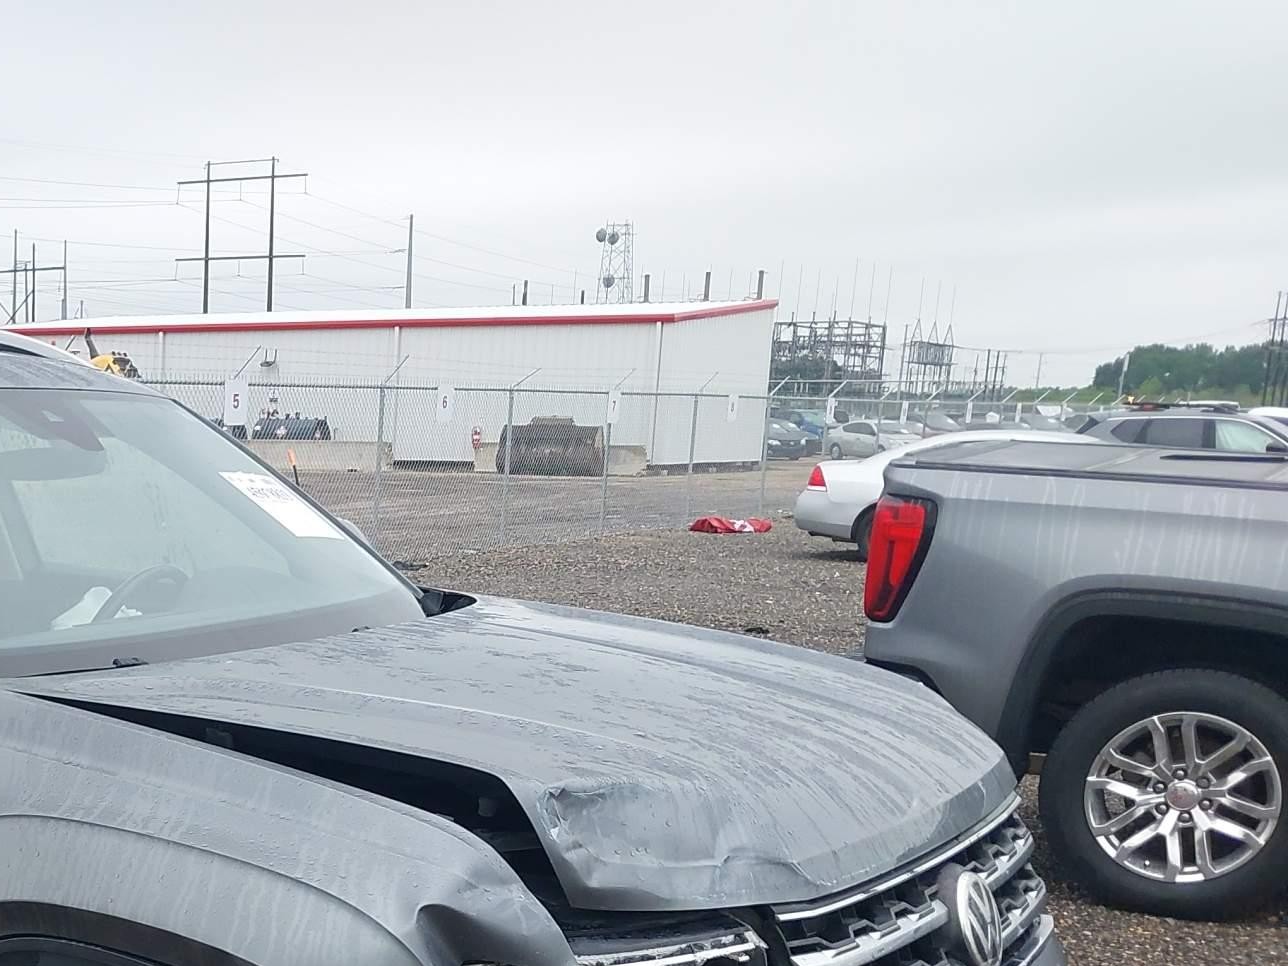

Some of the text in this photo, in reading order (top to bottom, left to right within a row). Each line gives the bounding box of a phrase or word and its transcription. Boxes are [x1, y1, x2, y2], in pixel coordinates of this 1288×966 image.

[232, 393, 240, 409] 5
[442, 395, 448, 409] 6
[612, 400, 617, 412] 7
